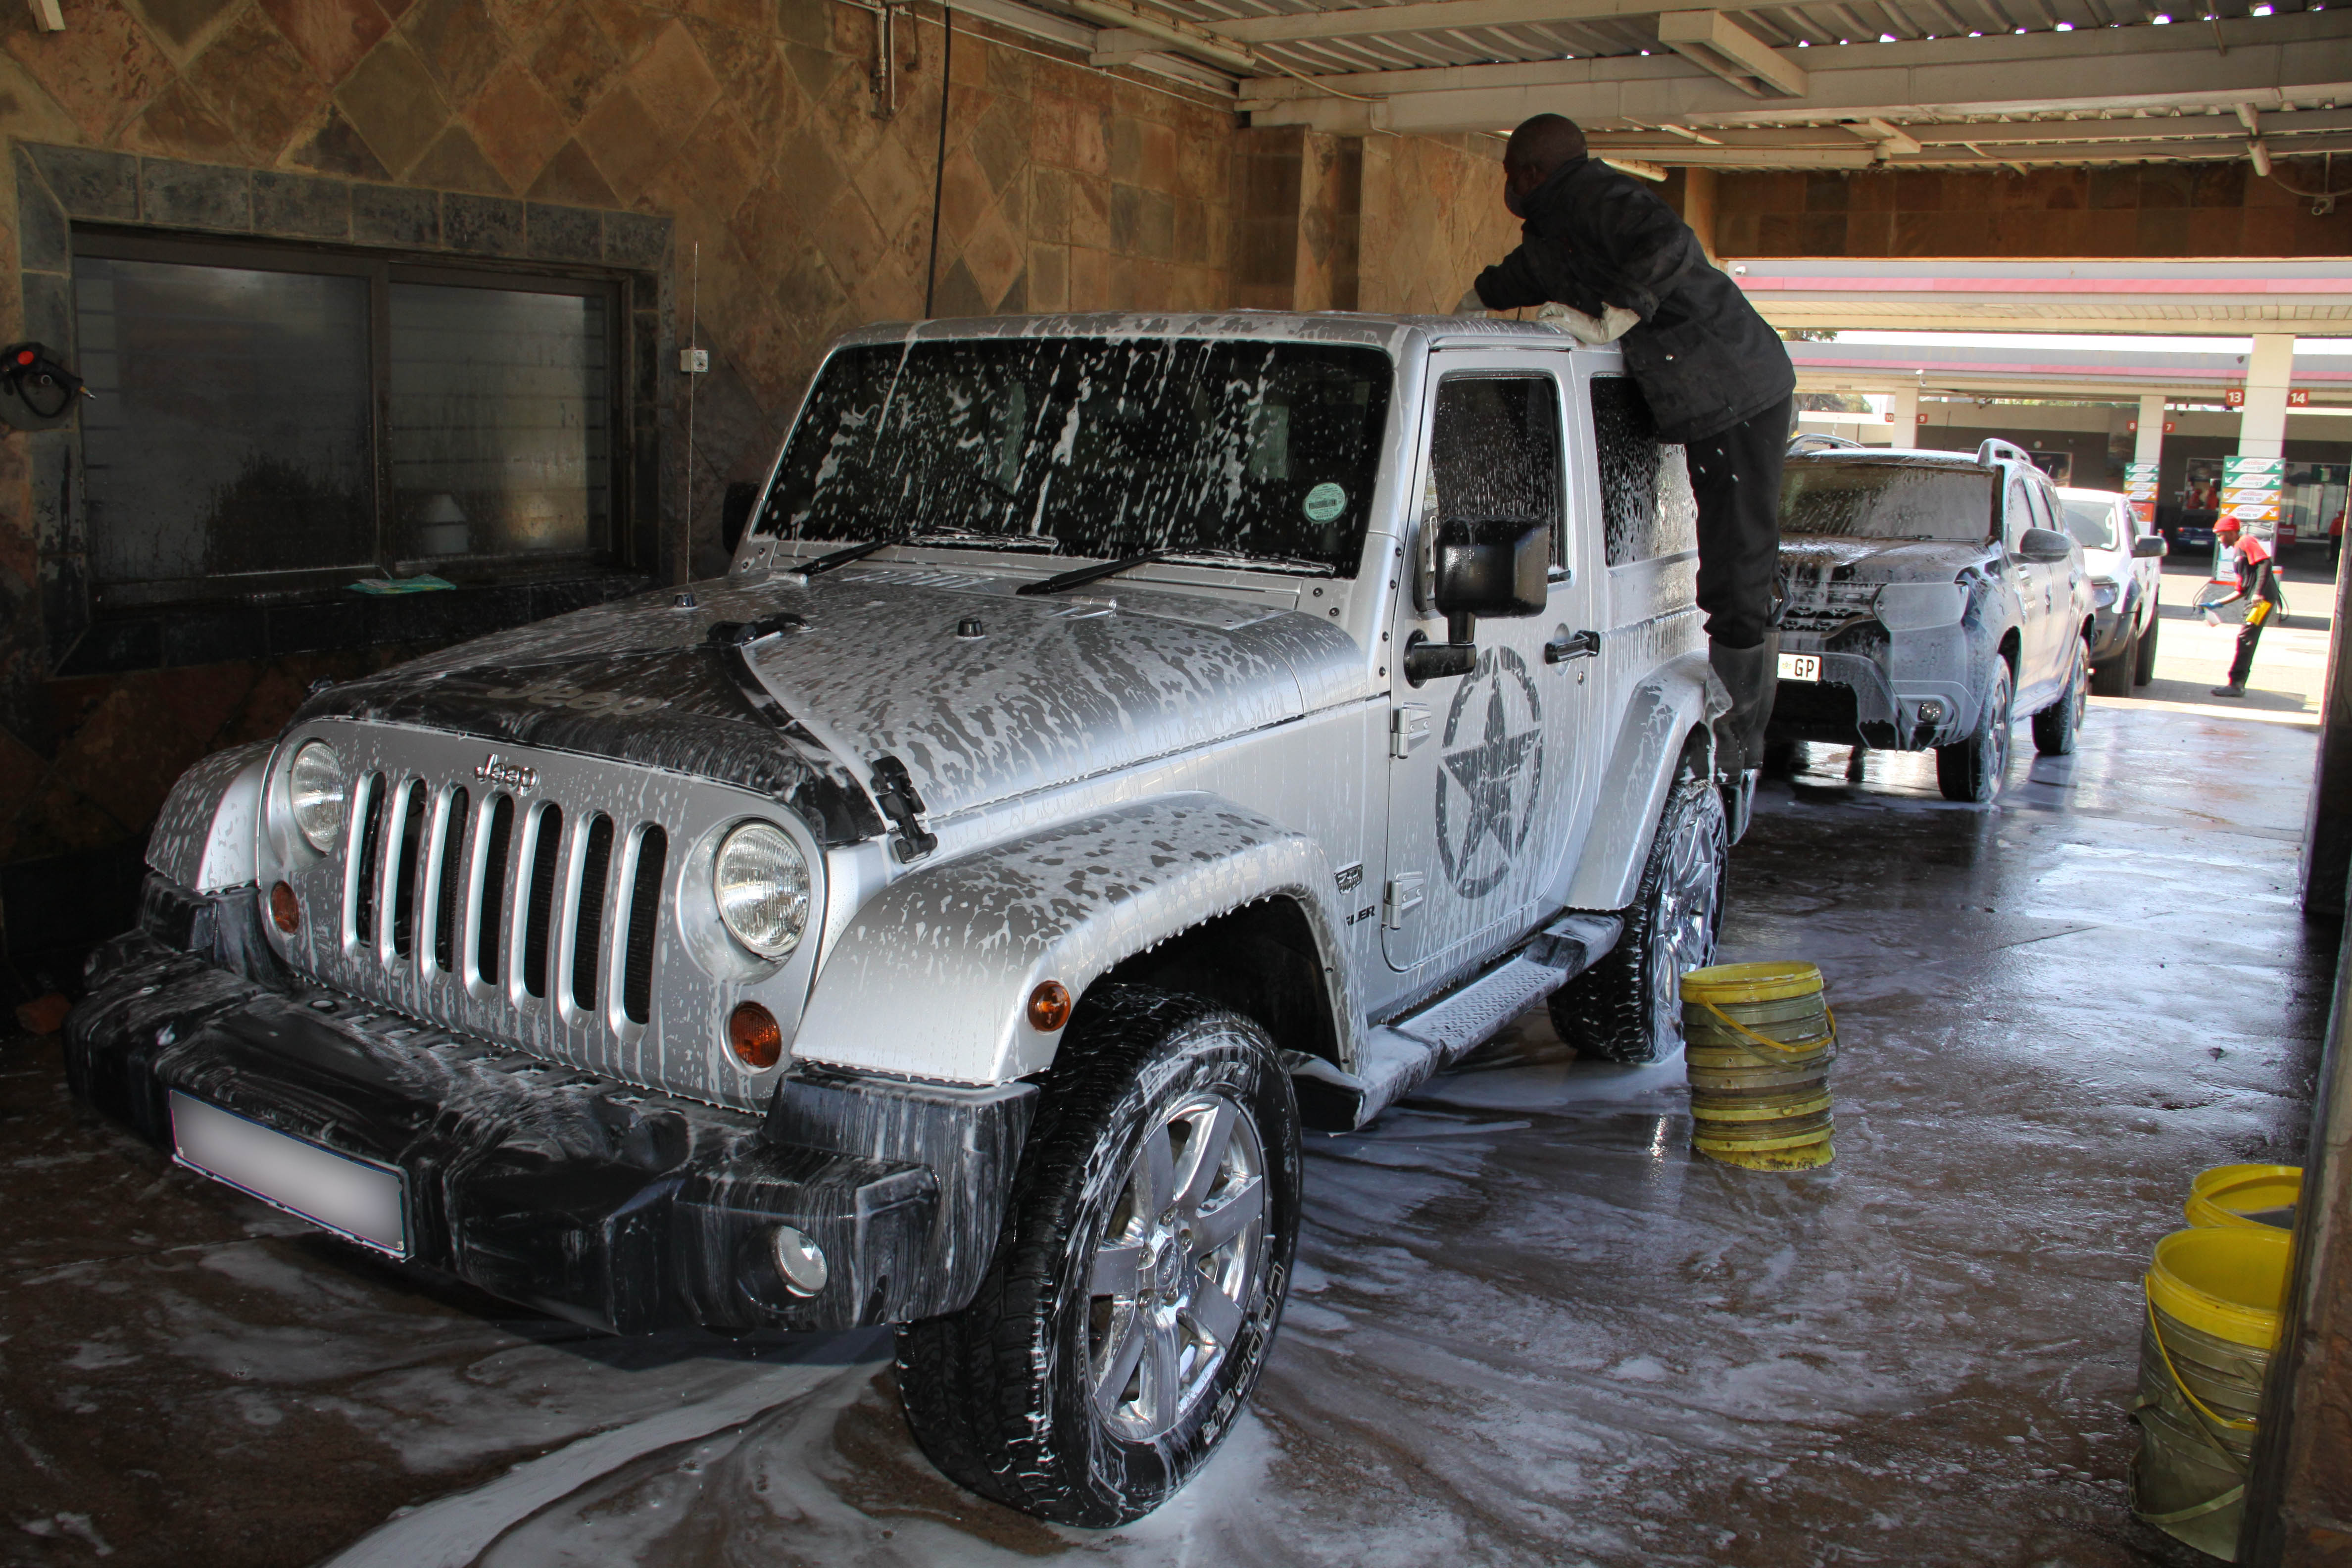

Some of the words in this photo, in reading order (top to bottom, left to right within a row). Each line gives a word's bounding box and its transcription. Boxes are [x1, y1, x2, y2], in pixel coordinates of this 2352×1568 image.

[2228, 392, 2242, 403] 13
[2291, 392, 2305, 404] 14
[1795, 658, 1814, 678] GP
[474, 754, 540, 796] Jeep
[1201, 1262, 1285, 1444] COOPER
